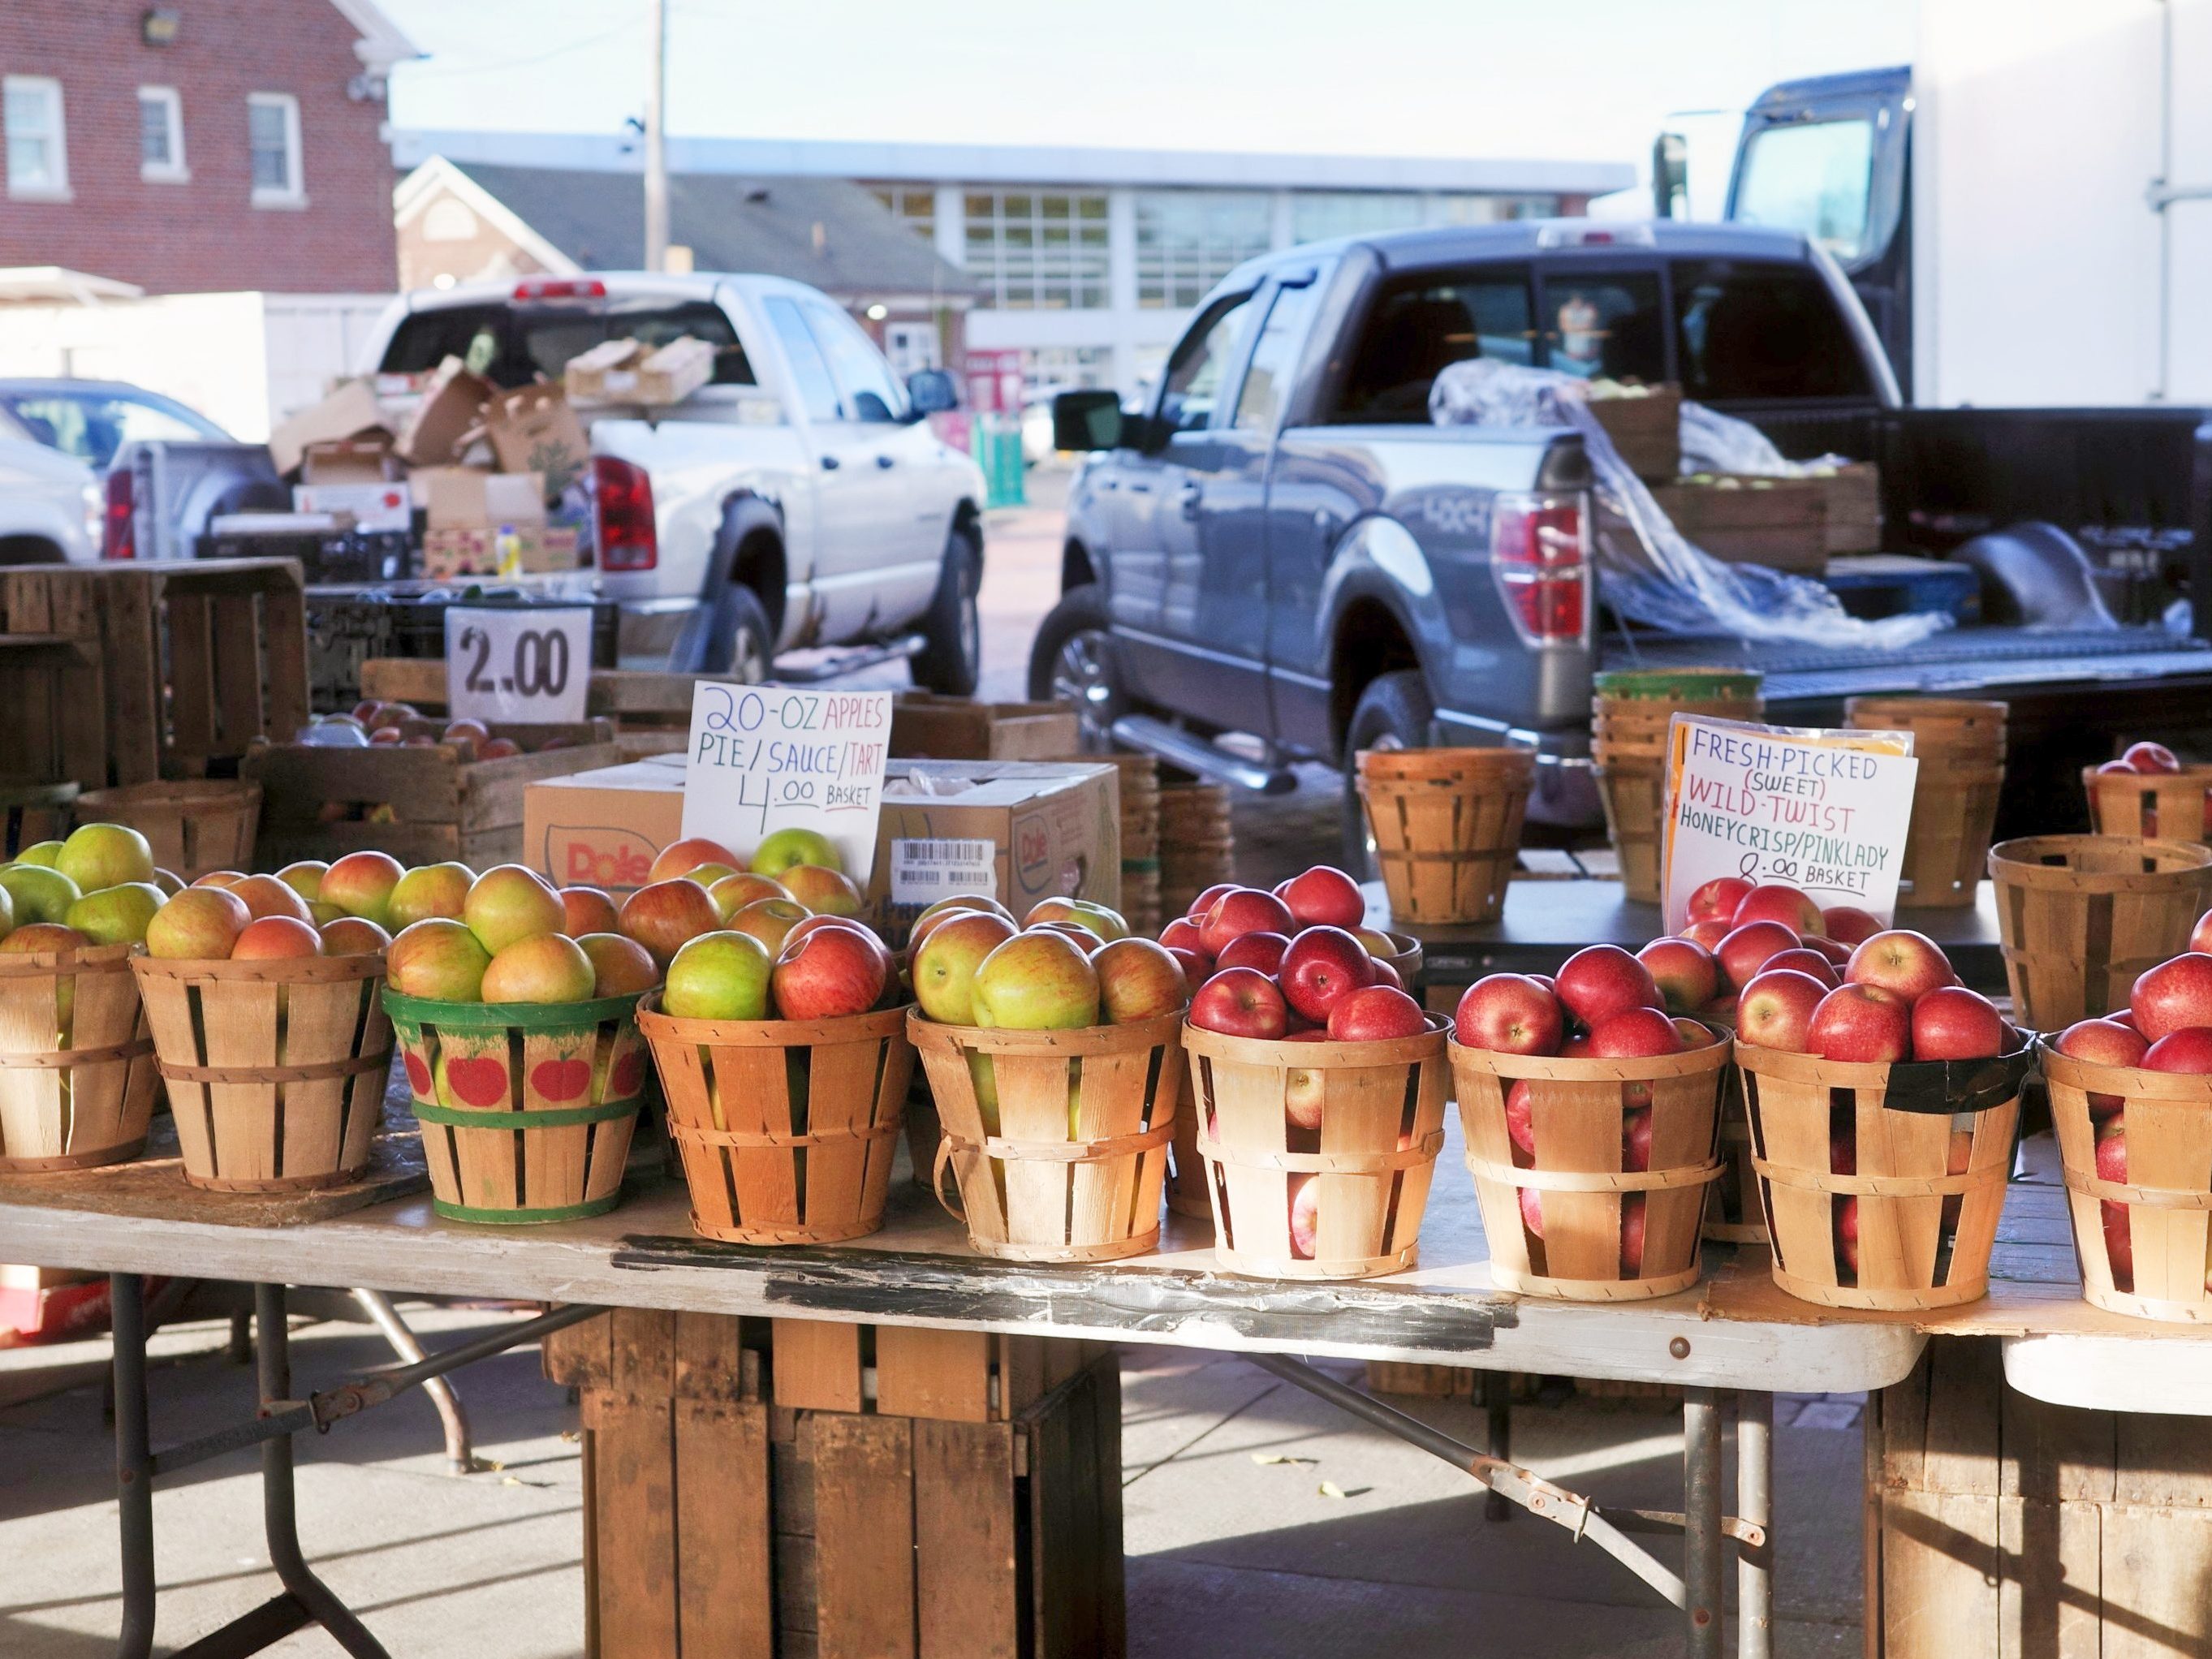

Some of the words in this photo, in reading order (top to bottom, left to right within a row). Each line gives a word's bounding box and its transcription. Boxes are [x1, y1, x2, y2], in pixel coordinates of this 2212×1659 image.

[459, 625, 569, 697] 2.00
[822, 697, 885, 730] APPLES
[1693, 728, 1878, 780] FRESH-PICKED
[738, 773, 820, 835] 4.00
[826, 785, 872, 806] BASKET
[1744, 769, 1826, 800] (SWEET)
[567, 842, 653, 886] Dole
[1739, 852, 1798, 887] 8.00
[1805, 865, 1871, 890] BASKET
